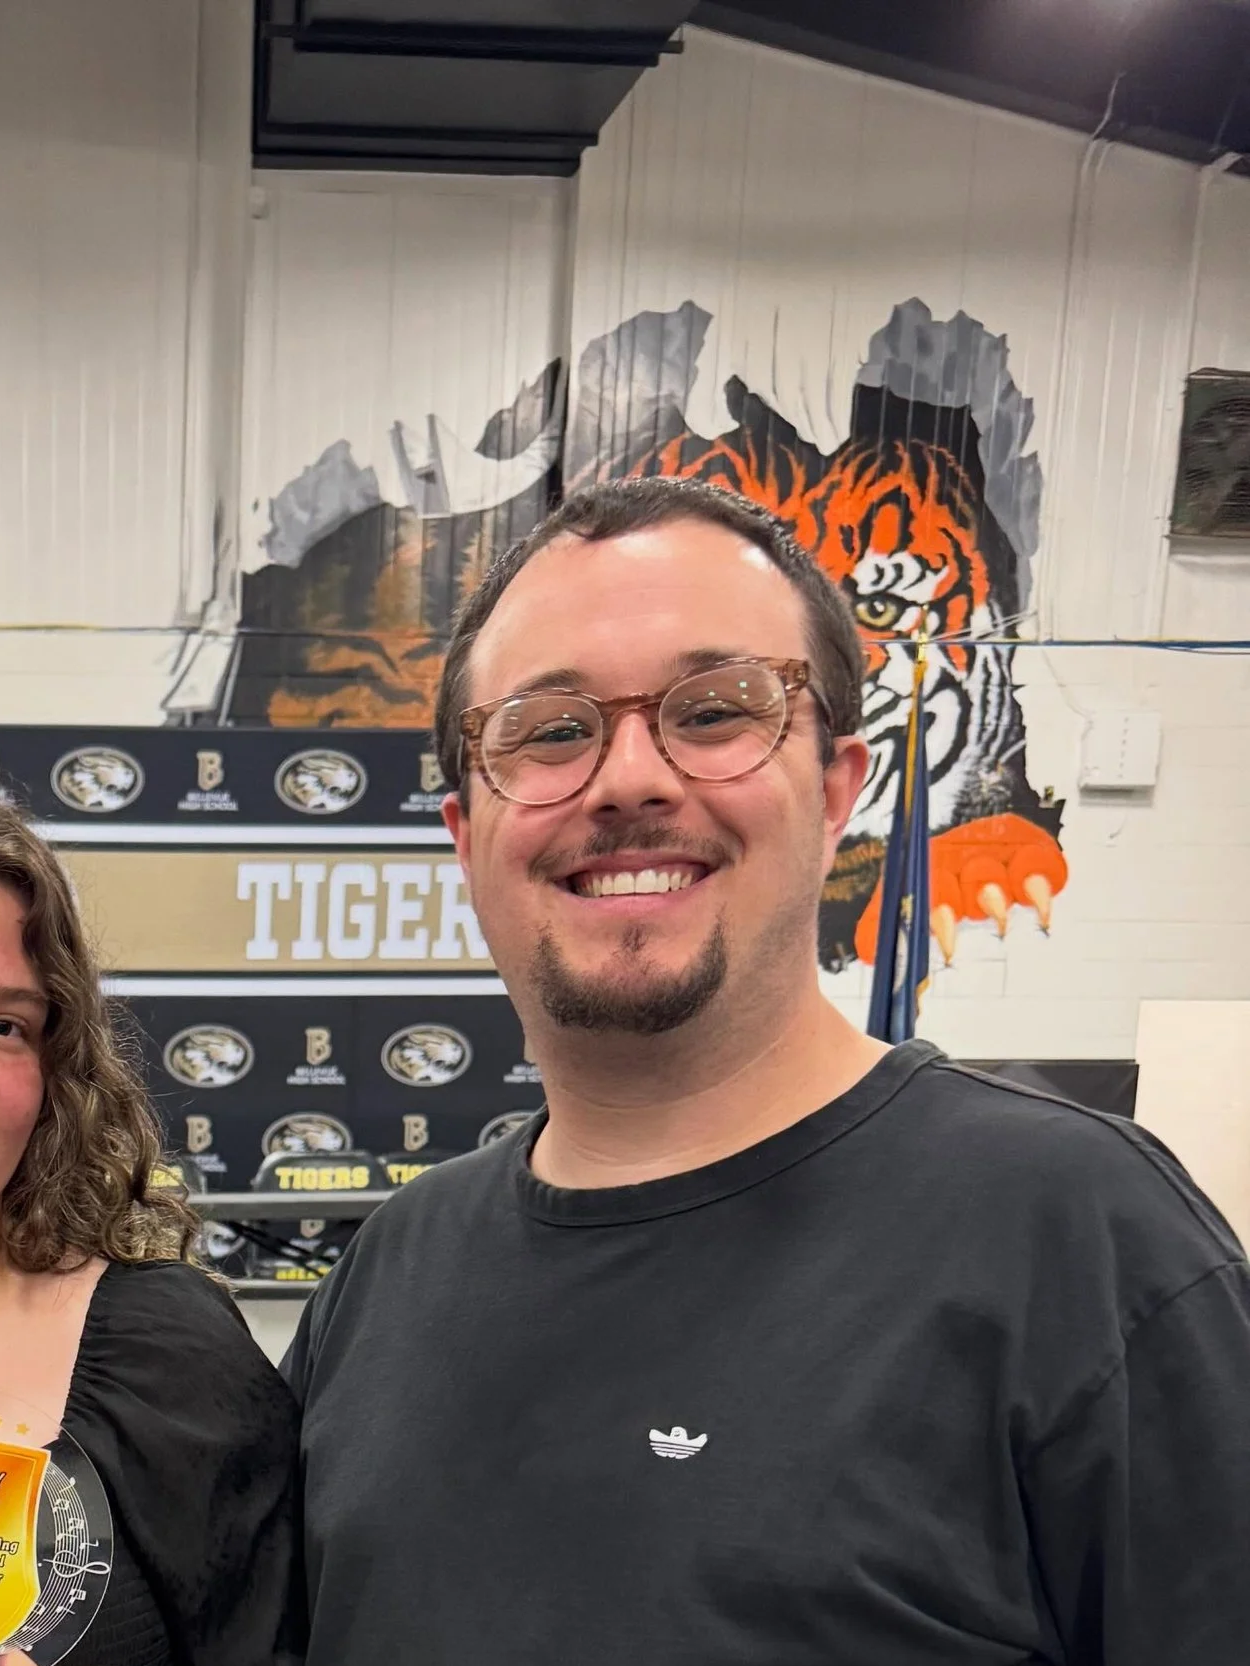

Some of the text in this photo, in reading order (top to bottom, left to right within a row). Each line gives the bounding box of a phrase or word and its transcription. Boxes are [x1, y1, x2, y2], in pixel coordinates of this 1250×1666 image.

[196, 750, 225, 791] B
[237, 862, 491, 960] TIGER
[304, 1026, 332, 1065] B
[186, 1114, 212, 1154] B
[402, 1114, 429, 1152] B
[274, 1165, 371, 1191] TIGERS
